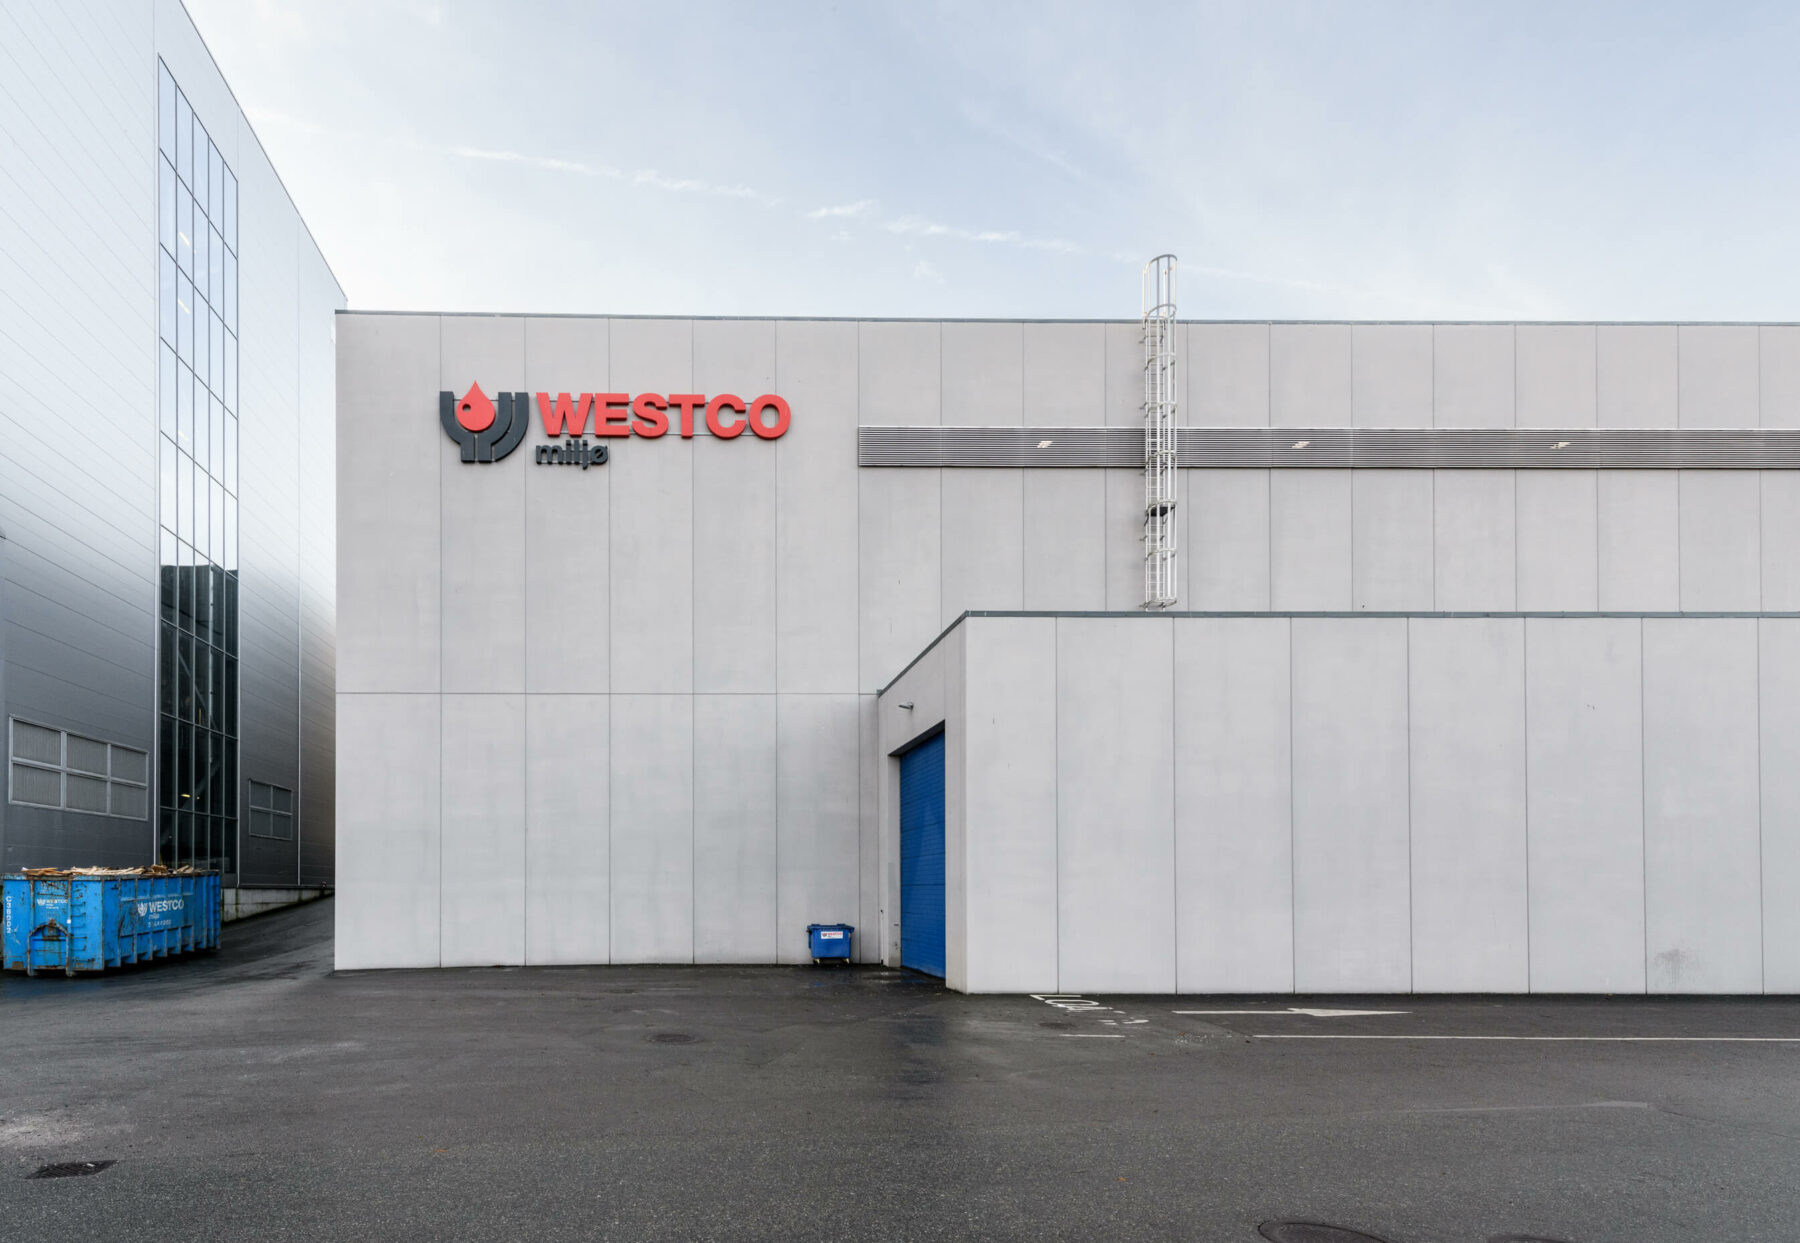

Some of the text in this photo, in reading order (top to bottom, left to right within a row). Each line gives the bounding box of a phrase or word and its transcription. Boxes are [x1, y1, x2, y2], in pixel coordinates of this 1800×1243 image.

[536, 392, 791, 439] WESTCO
[536, 440, 608, 470] miljø
[149, 898, 185, 913] WESTCO
